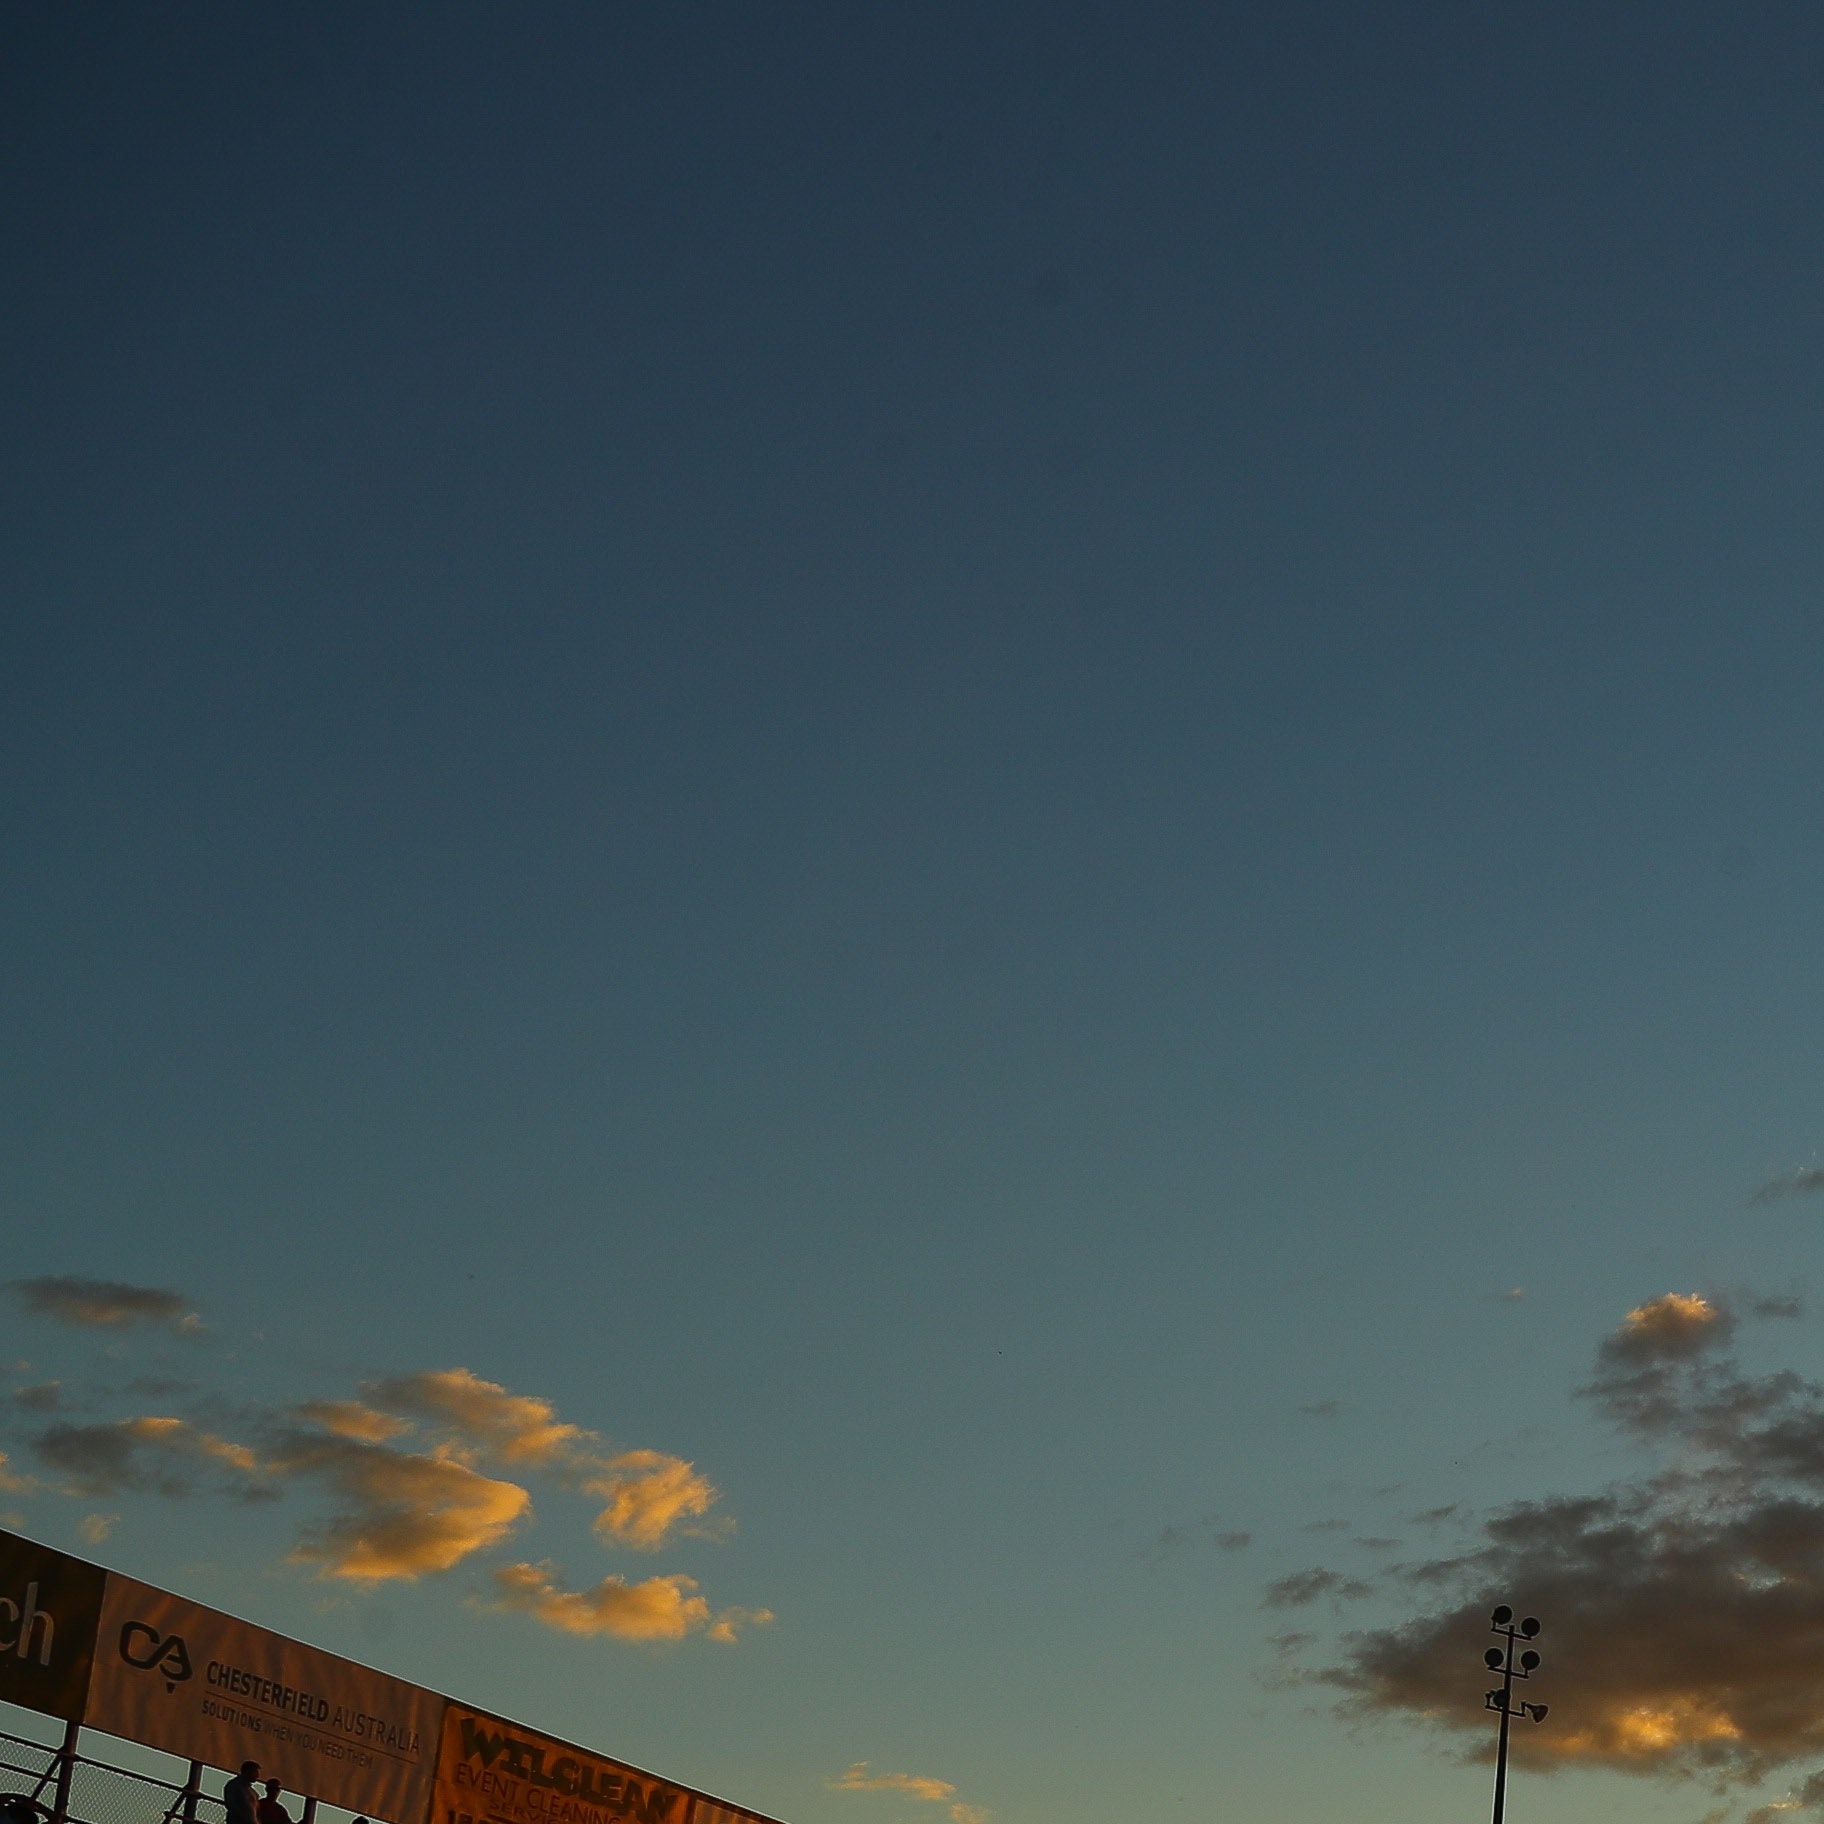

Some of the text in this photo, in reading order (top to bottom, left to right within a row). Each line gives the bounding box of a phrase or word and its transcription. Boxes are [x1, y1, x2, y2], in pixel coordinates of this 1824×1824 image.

[201, 1700, 262, 1732] SOLUTIONS
[320, 1738, 344, 1760] NEED
[206, 1661, 420, 1754] CHESTERFIELD AUSTRALIA
[456, 1763, 520, 1799] EVENT
[460, 1718, 678, 1824] WILCLEAN
